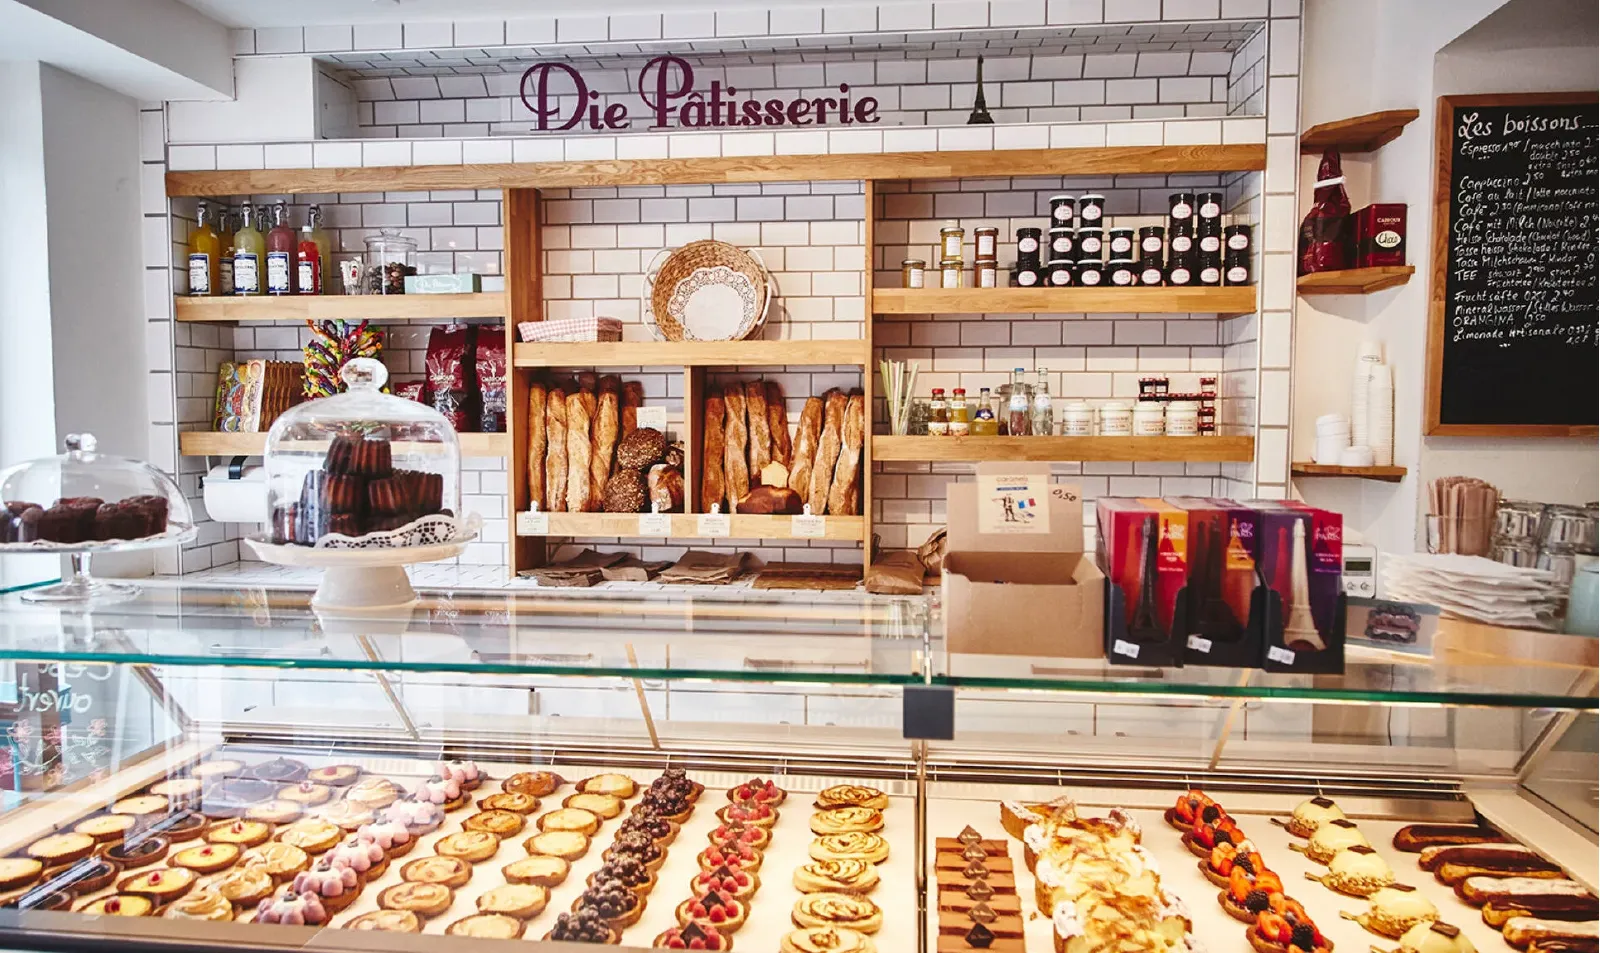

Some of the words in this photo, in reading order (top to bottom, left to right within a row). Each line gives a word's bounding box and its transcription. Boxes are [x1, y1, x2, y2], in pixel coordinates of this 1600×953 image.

[519, 62, 630, 131] Die
[638, 55, 881, 128] Pâtisserie
[1458, 112, 1493, 140] Les
[1503, 113, 1583, 136] boissons
[1460, 140, 1502, 160] Espresso
[1460, 175, 1520, 191] Cappuccino
[1488, 193, 1500, 201] au
[1506, 214, 1535, 230] Milch
[1454, 244, 1479, 257] Tasse
[1455, 257, 1479, 268] Tasse
[1454, 268, 1479, 282] TEE
[1452, 313, 1514, 327] ORANGINA
[1452, 326, 1504, 342] Limonade
